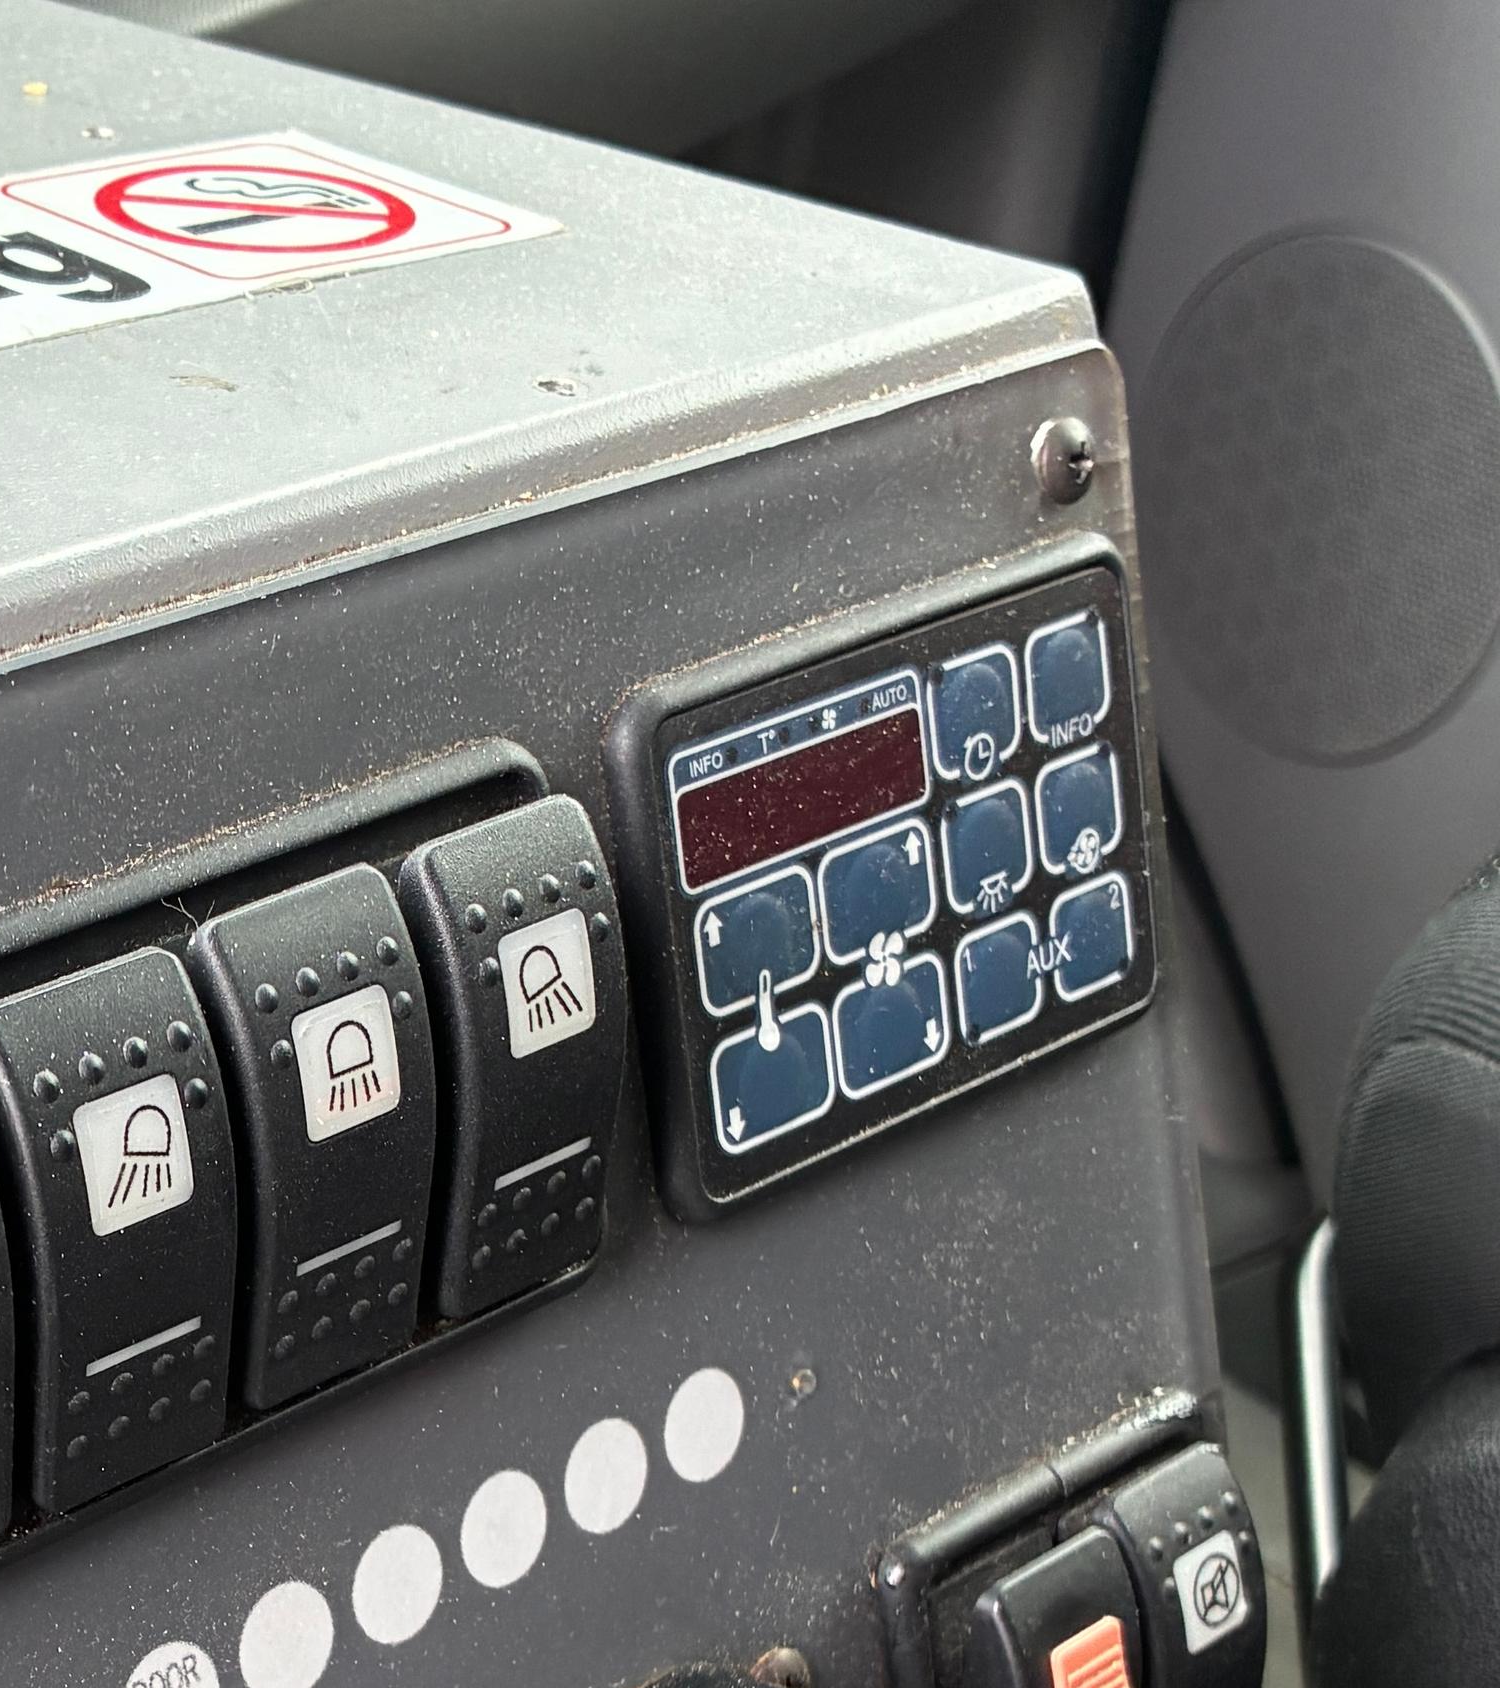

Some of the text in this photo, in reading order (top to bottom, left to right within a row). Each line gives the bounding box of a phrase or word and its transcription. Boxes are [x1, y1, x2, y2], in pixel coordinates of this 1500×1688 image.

[689, 750, 724, 778] INFO
[871, 684, 908, 712] AUTO
[1051, 712, 1093, 749] INFO
[1108, 884, 1121, 909] 2
[962, 947, 974, 973] 1
[1026, 931, 1073, 979] AUX
